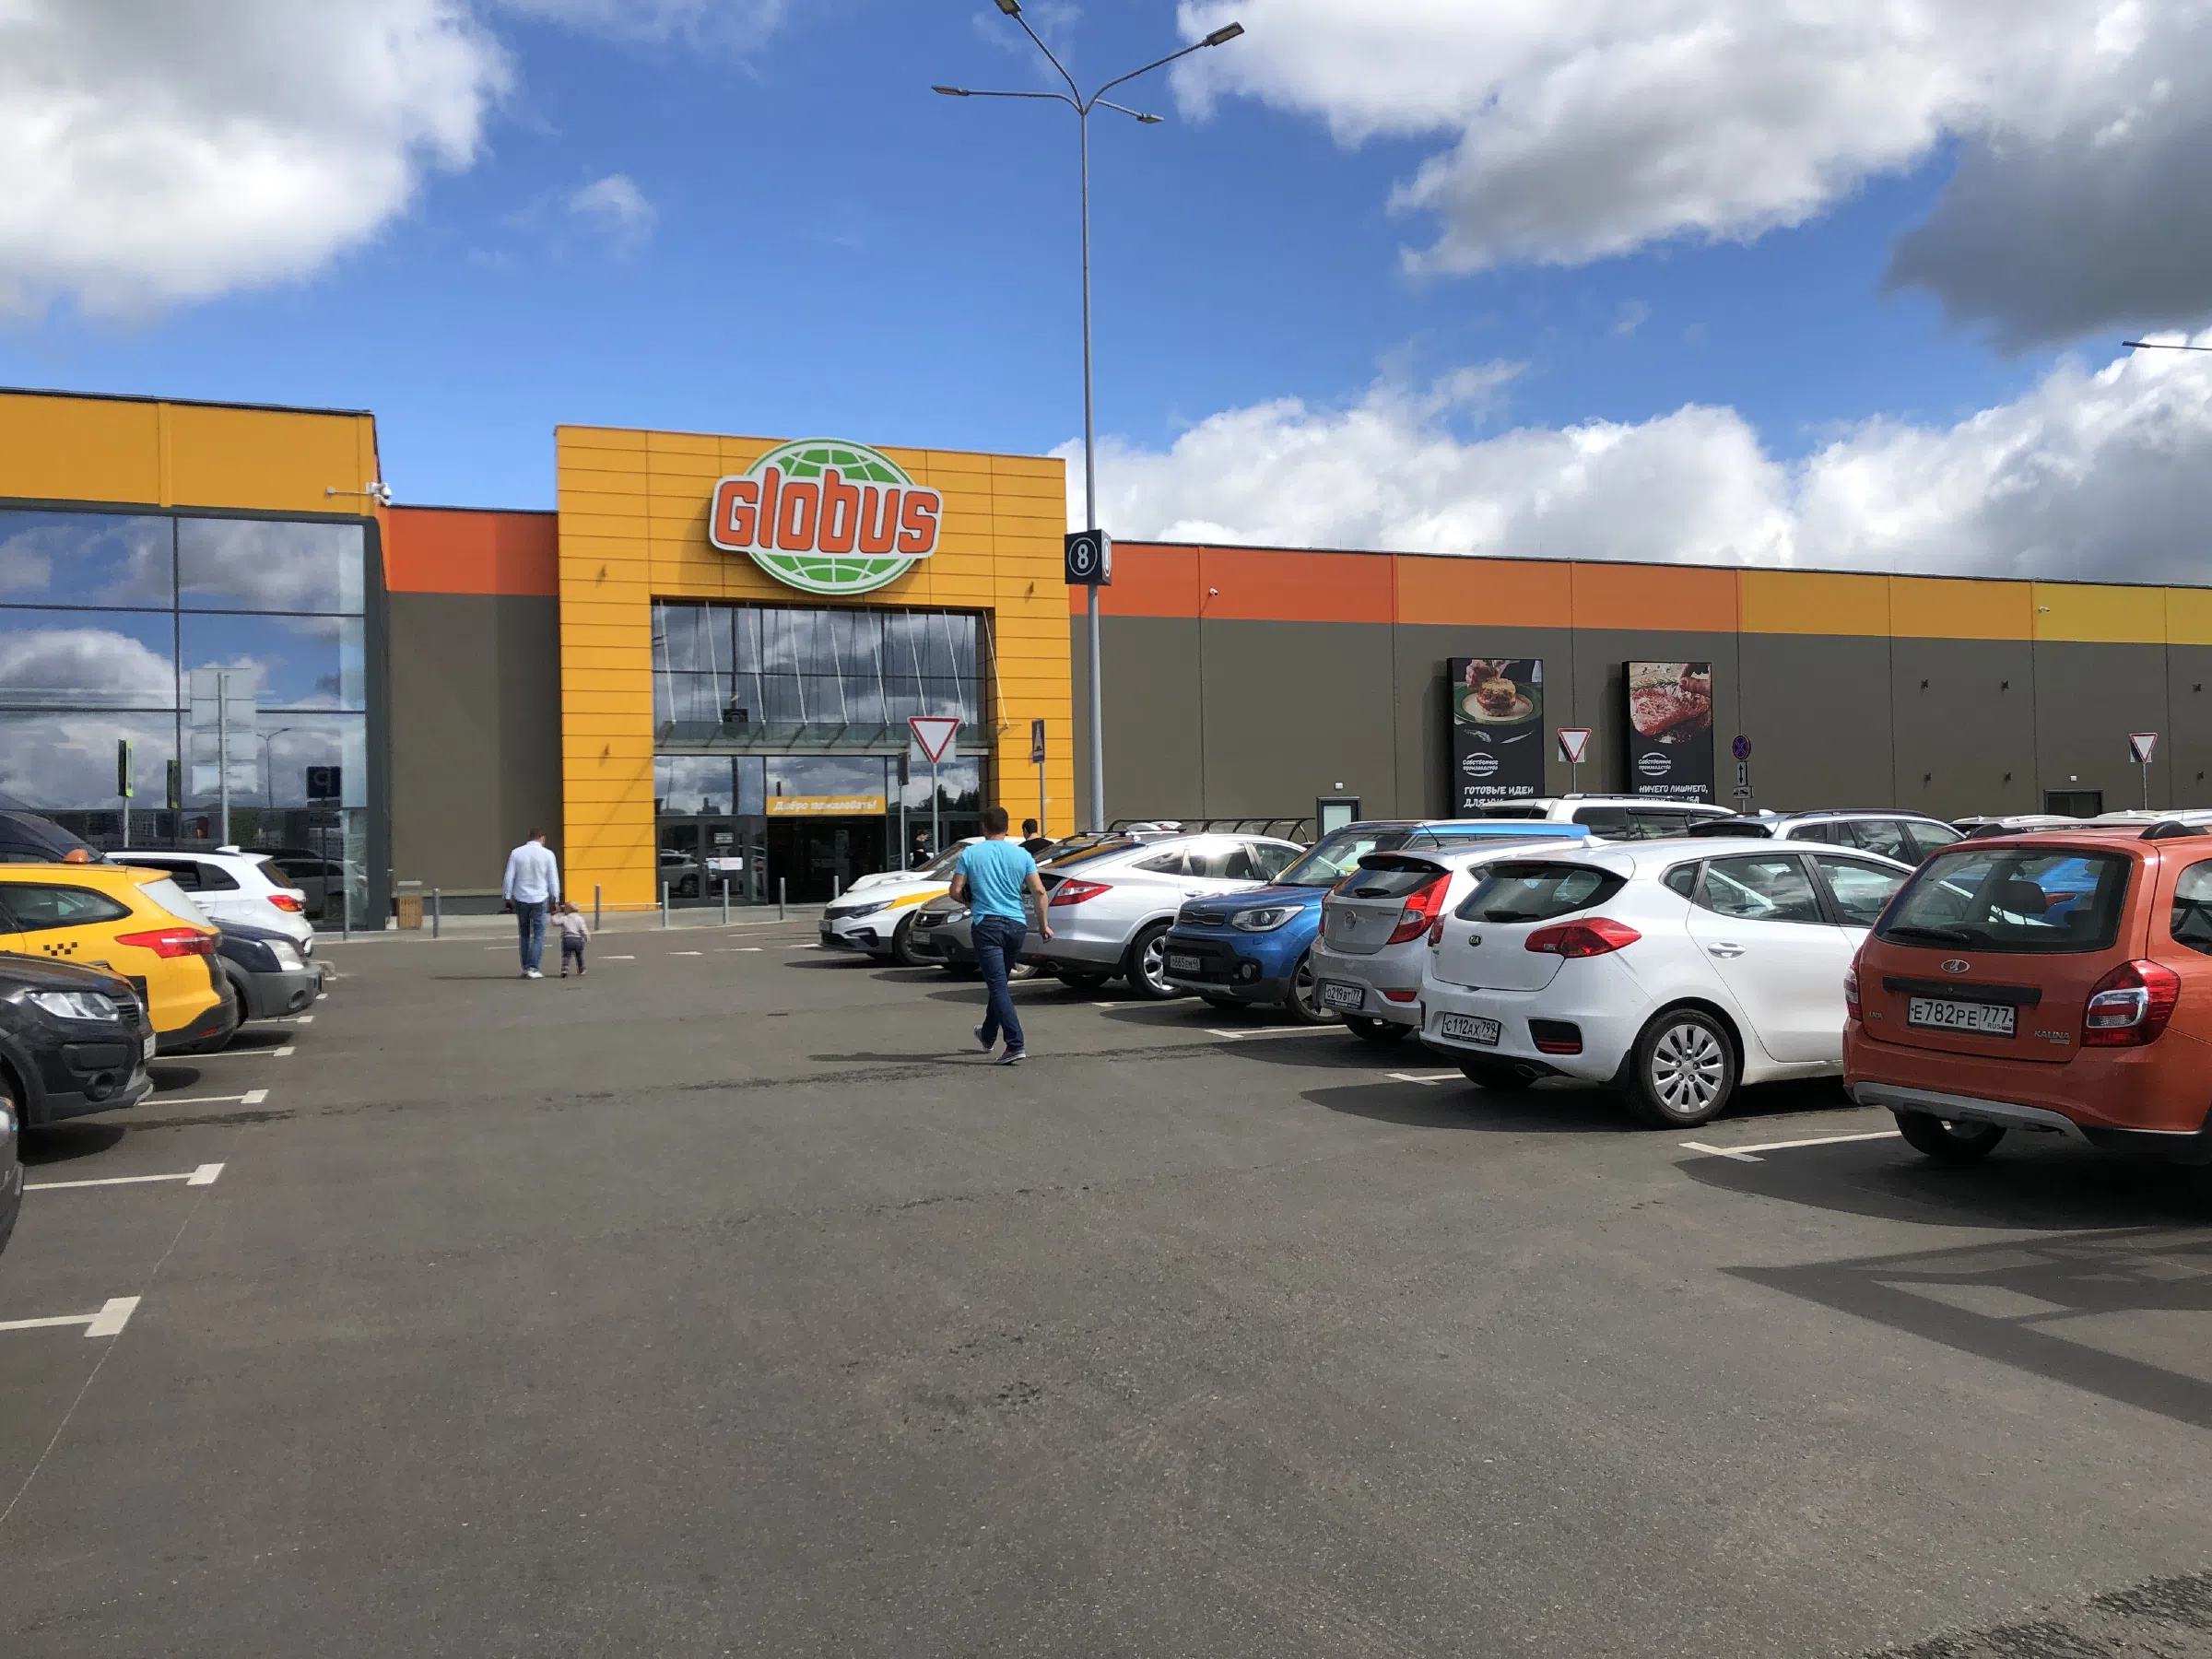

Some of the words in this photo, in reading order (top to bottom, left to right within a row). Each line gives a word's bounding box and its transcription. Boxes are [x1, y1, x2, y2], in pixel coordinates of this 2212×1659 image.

[715, 467, 939, 554] Globus
[1077, 544, 1088, 569] 8
[1464, 785, 1507, 794] ГОТОВЫЕ
[1508, 786, 1535, 795] ИДЕИ
[1639, 784, 1669, 794] НИЧЕГО
[1670, 783, 1709, 794] ЛИШНЕГО,
[1987, 1021, 2001, 1030] RUS
